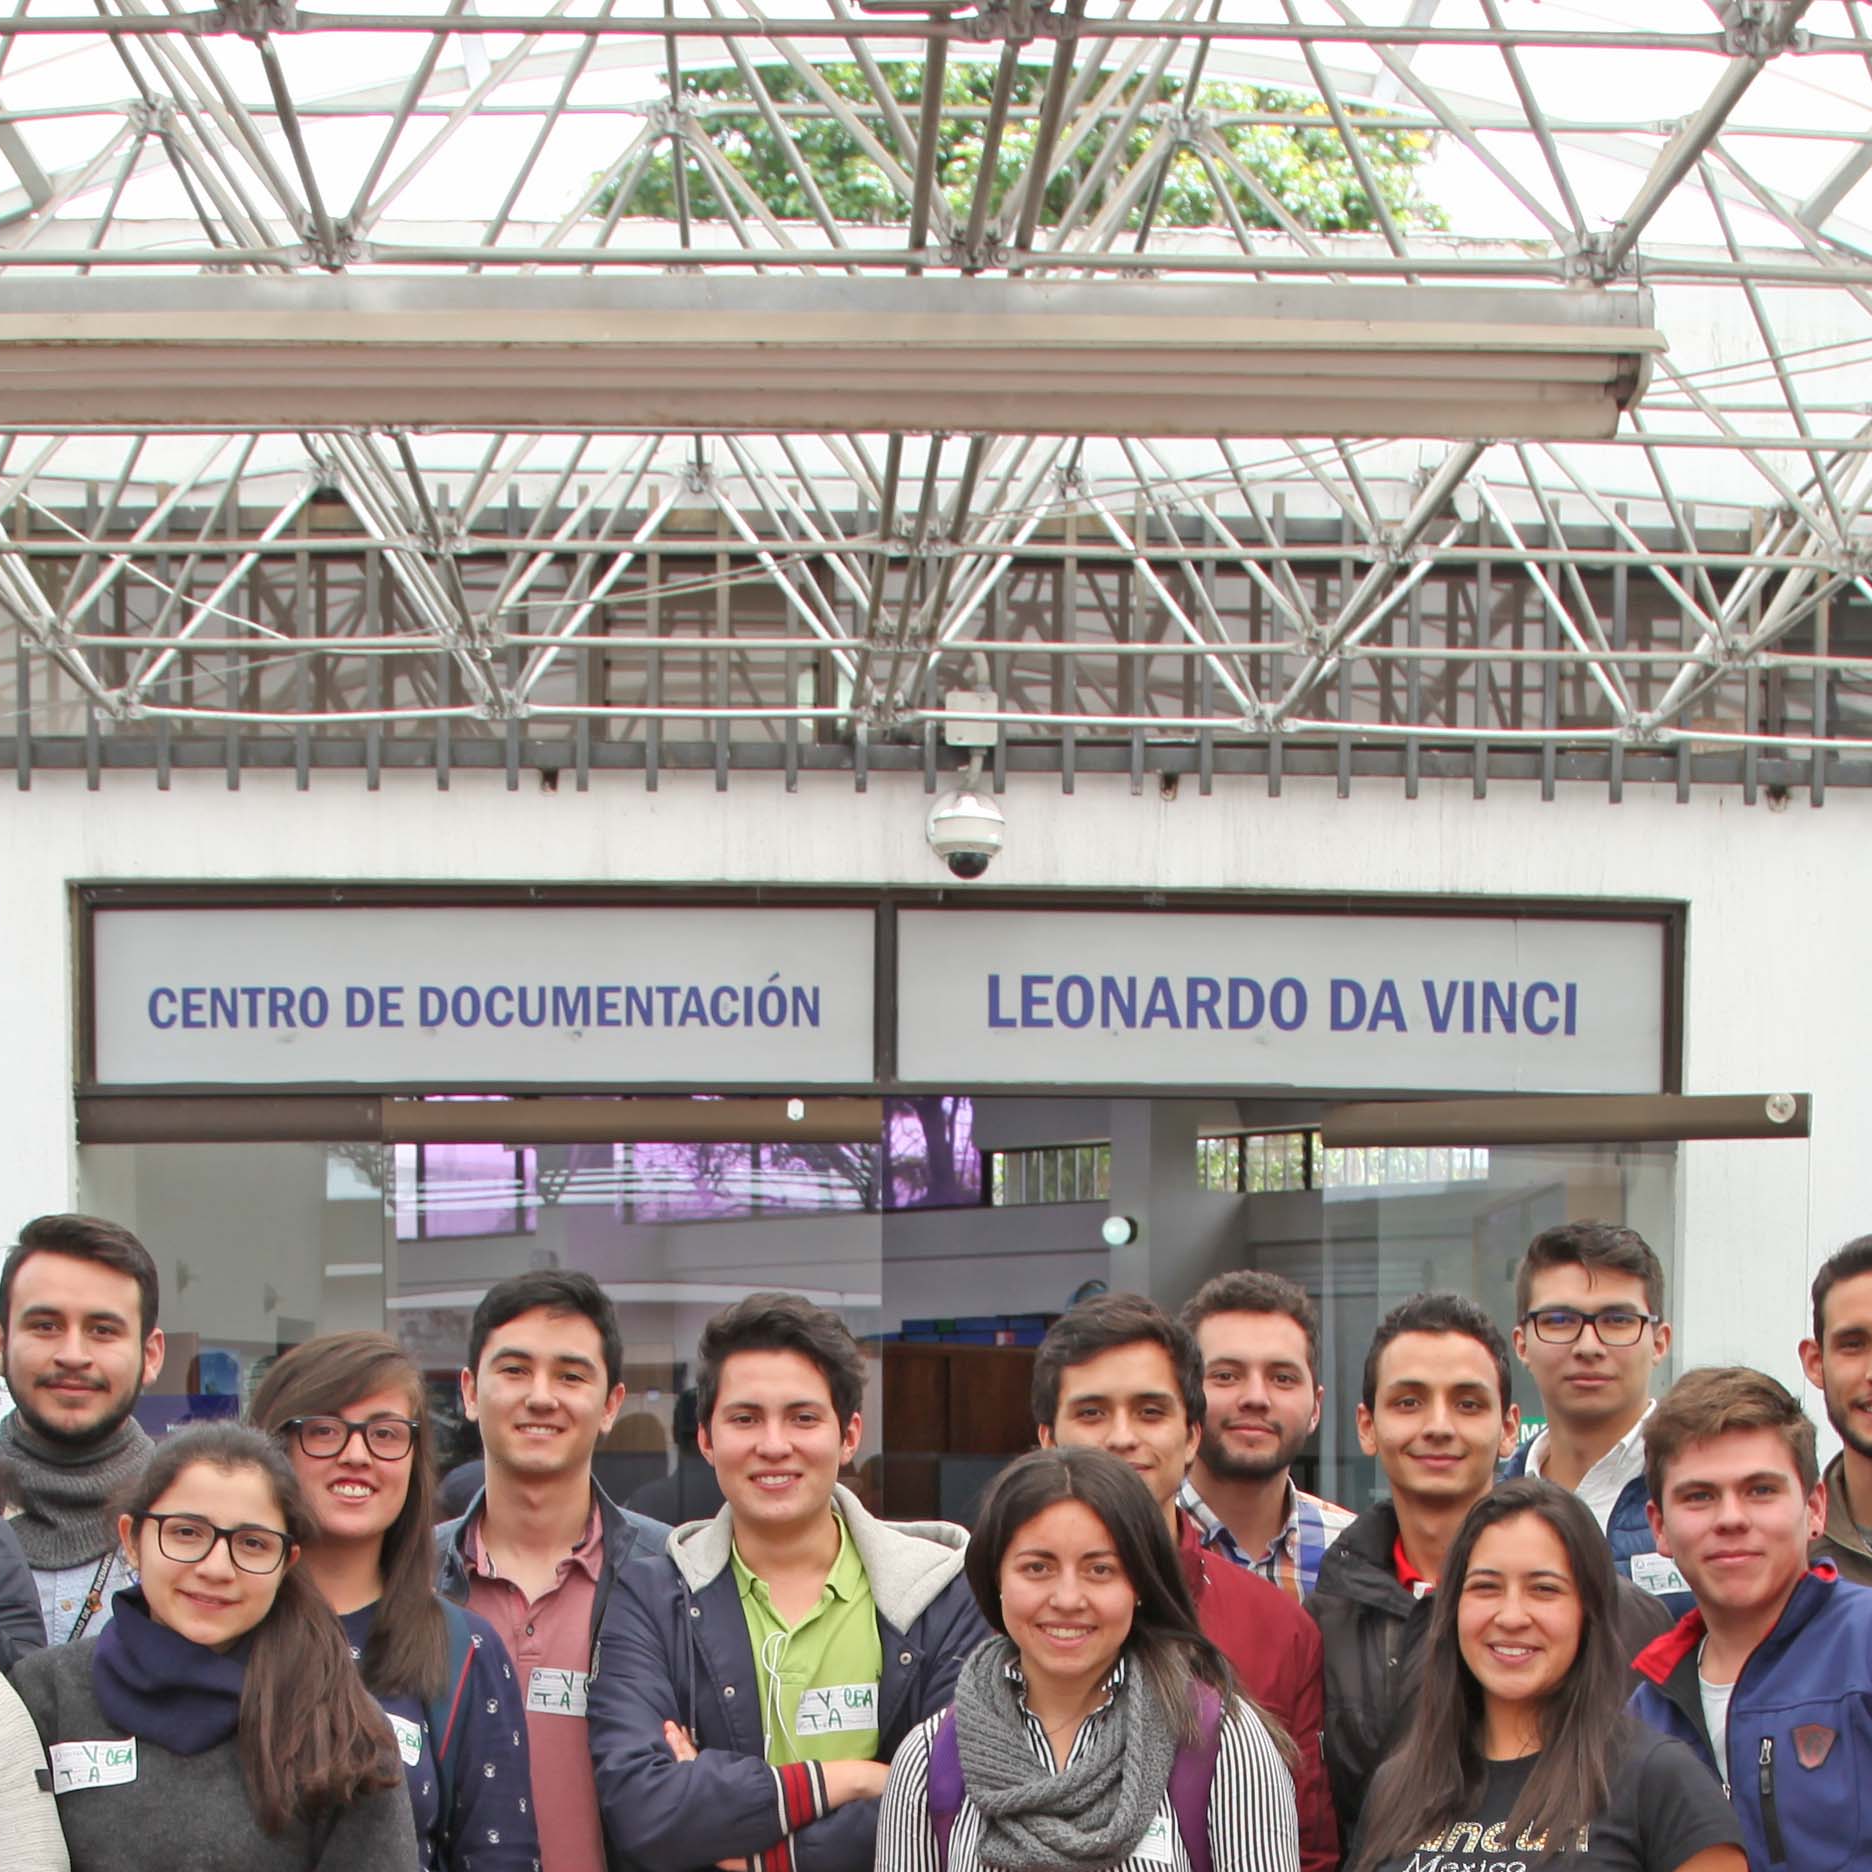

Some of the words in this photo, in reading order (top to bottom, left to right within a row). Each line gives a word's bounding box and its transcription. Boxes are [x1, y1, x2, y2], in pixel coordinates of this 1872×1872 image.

[147, 986, 329, 1029] CENTRO
[344, 986, 405, 1028] DE
[417, 972, 820, 1028] DOCUMENTACIÓN
[987, 973, 1308, 1032] LEONARDO
[1329, 977, 1408, 1034] DA
[1421, 979, 1578, 1036] VINCI
